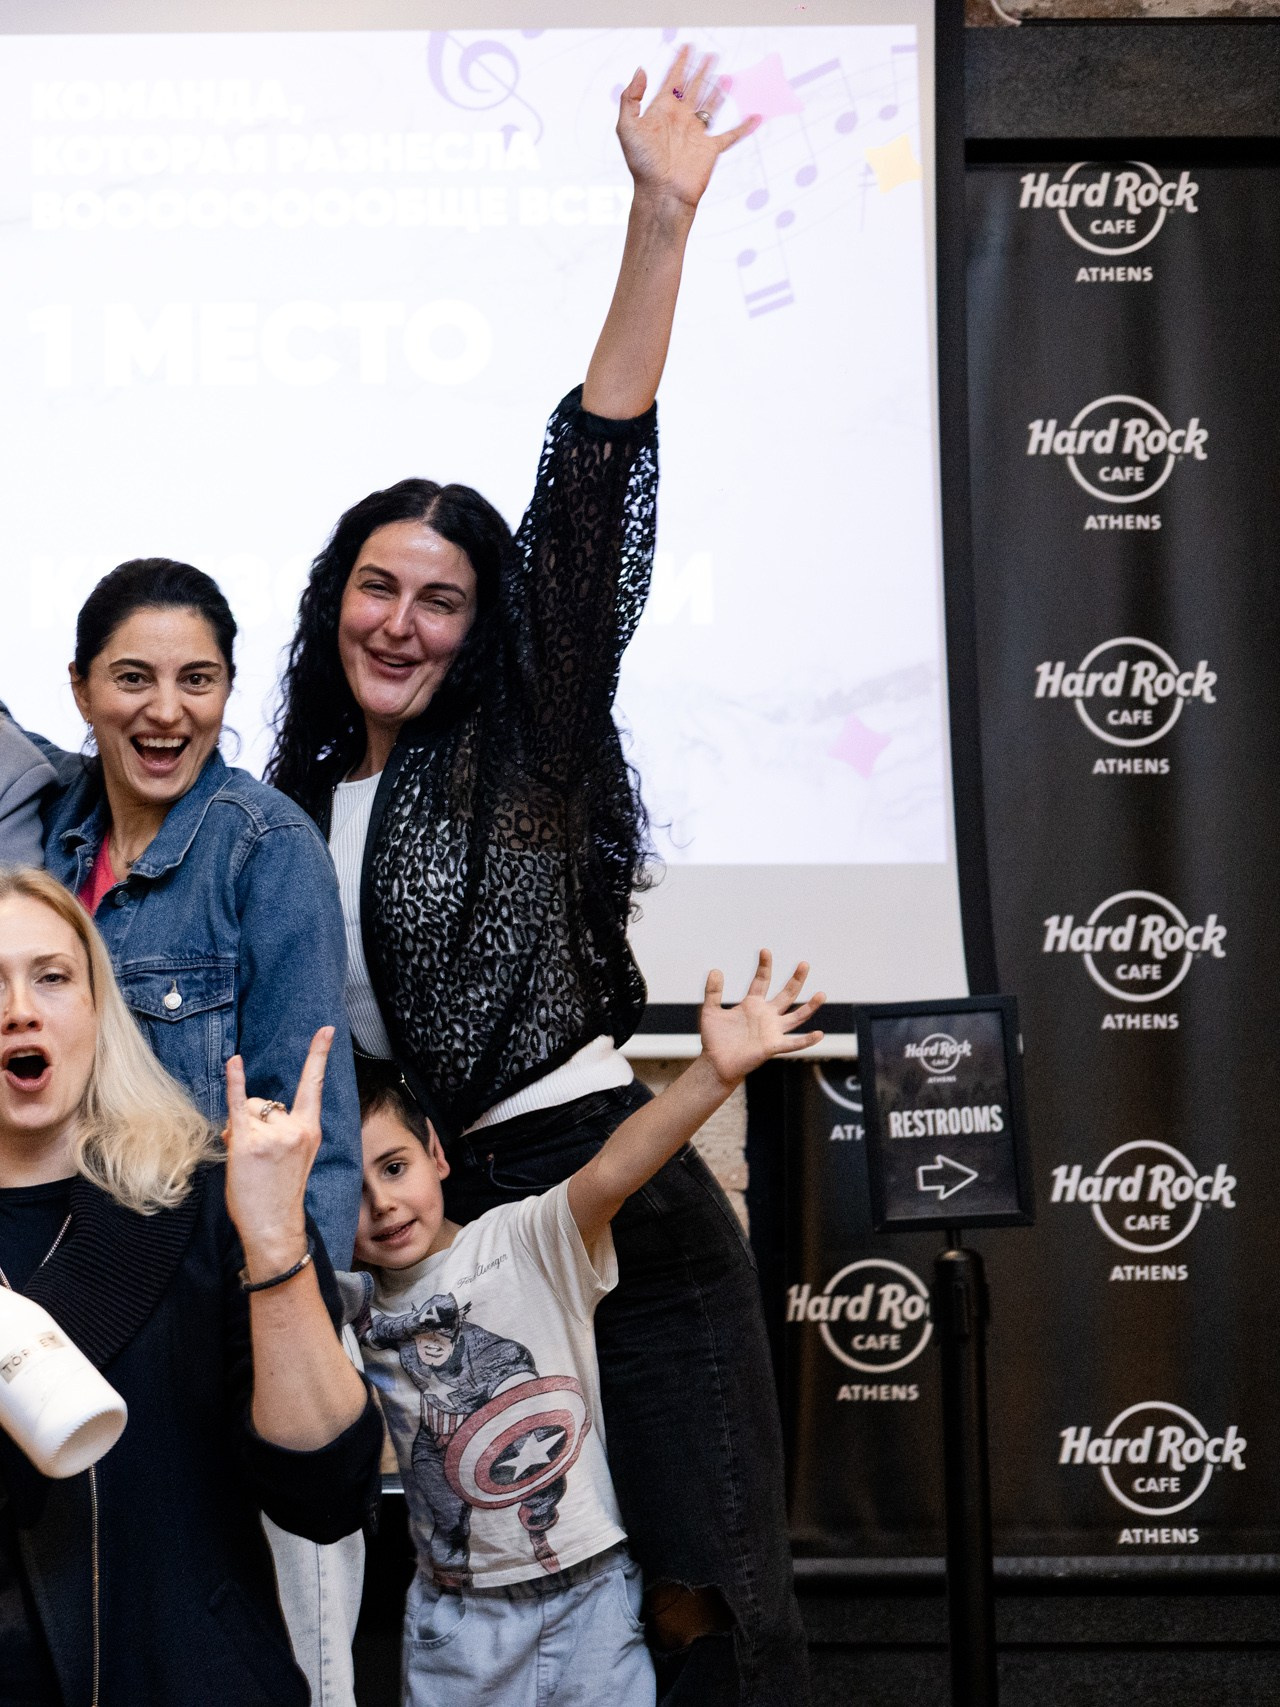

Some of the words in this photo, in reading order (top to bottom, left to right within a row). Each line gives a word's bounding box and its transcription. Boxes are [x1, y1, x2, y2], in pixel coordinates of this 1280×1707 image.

[31, 79, 306, 125] КОМАНДА,
[31, 134, 266, 176] КОТОРАЯ
[277, 131, 542, 172] РАЗНЕСЛА
[1020, 172, 1111, 208] Hard
[1113, 171, 1199, 214] Rock
[1090, 219, 1136, 234] CAFE
[1075, 266, 1154, 282] ATHENS
[27, 303, 72, 388] 1
[104, 298, 493, 386] МЕСТО
[1027, 418, 1120, 455] Hard
[1122, 417, 1209, 462] Rock
[1099, 466, 1145, 482] CAFE
[1083, 514, 1162, 530] ATHENS
[1035, 660, 1128, 698] Hard
[1130, 660, 1217, 705] Rock
[1107, 709, 1153, 725] CAFE
[1092, 758, 1170, 774] ATHENS
[1043, 914, 1137, 952] Hard
[1139, 914, 1227, 960] Rock
[1116, 964, 1162, 980] CAFE
[1101, 1013, 1179, 1030] ATHENS
[904, 1041, 939, 1059] Hard
[940, 1039, 972, 1058] Rock
[889, 1104, 1004, 1139] RESTROOMS
[1050, 1164, 1146, 1202] Hard
[1147, 1164, 1237, 1210] Rock
[1124, 1215, 1170, 1231] CAFE
[1109, 1265, 1188, 1281] ATHENS
[786, 1283, 874, 1322] Hard
[876, 1283, 930, 1330] Ro
[852, 1334, 901, 1350] CAFE
[837, 1384, 920, 1401] ATHENS
[1058, 1426, 1154, 1464] Hard
[1156, 1425, 1247, 1472] Rock
[1133, 1477, 1181, 1493] CAFE
[1119, 1528, 1200, 1544] ATHENS
